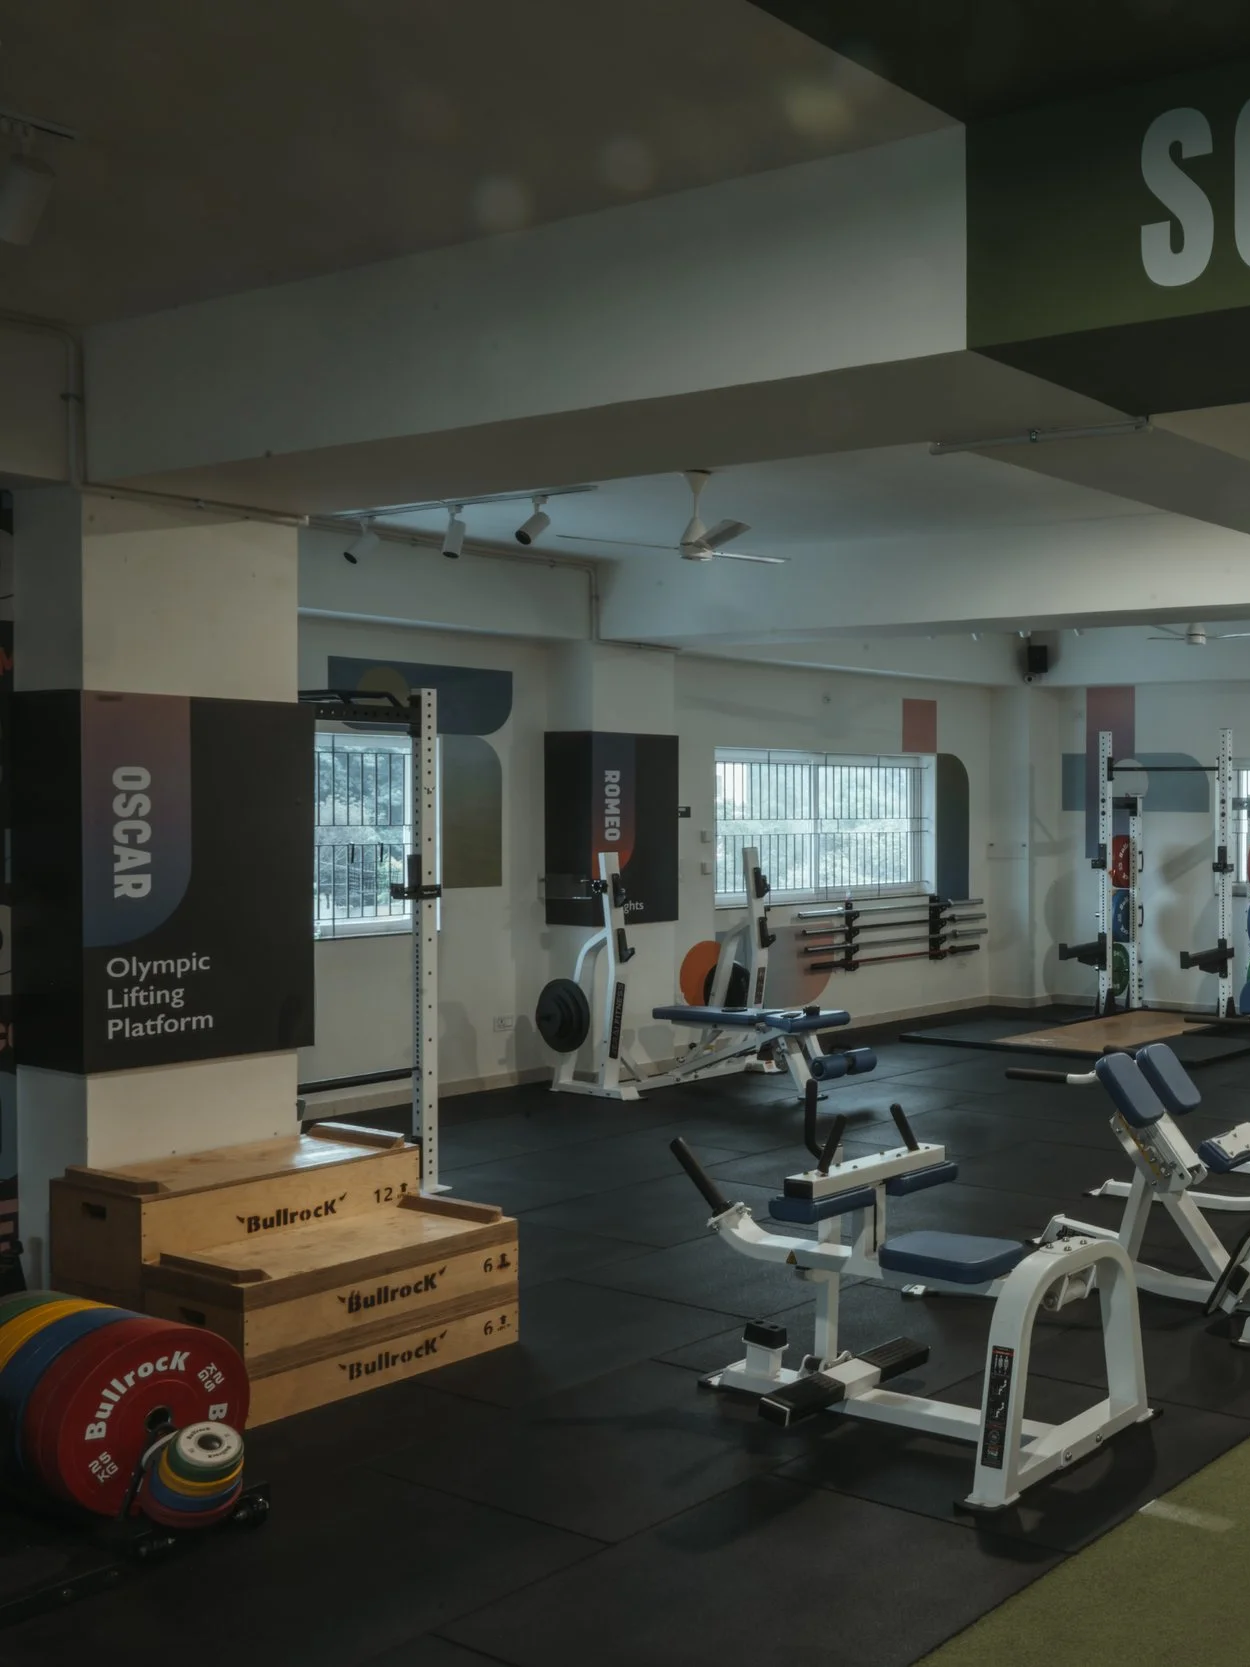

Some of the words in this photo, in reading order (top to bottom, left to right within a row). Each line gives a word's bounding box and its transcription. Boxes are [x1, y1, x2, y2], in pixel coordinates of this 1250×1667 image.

[604, 770, 621, 841] ROMEO
[112, 766, 152, 898] OSCAR
[624, 901, 644, 914] ghts
[106, 952, 211, 982] Olympic
[107, 986, 185, 1009] Lifting
[107, 1013, 214, 1040] Platform
[374, 1187, 393, 1204] 12
[483, 1258, 494, 1273] 6
[484, 1320, 494, 1336] 6
[88, 1451, 112, 1475] 25
[97, 1463, 119, 1484] KG
